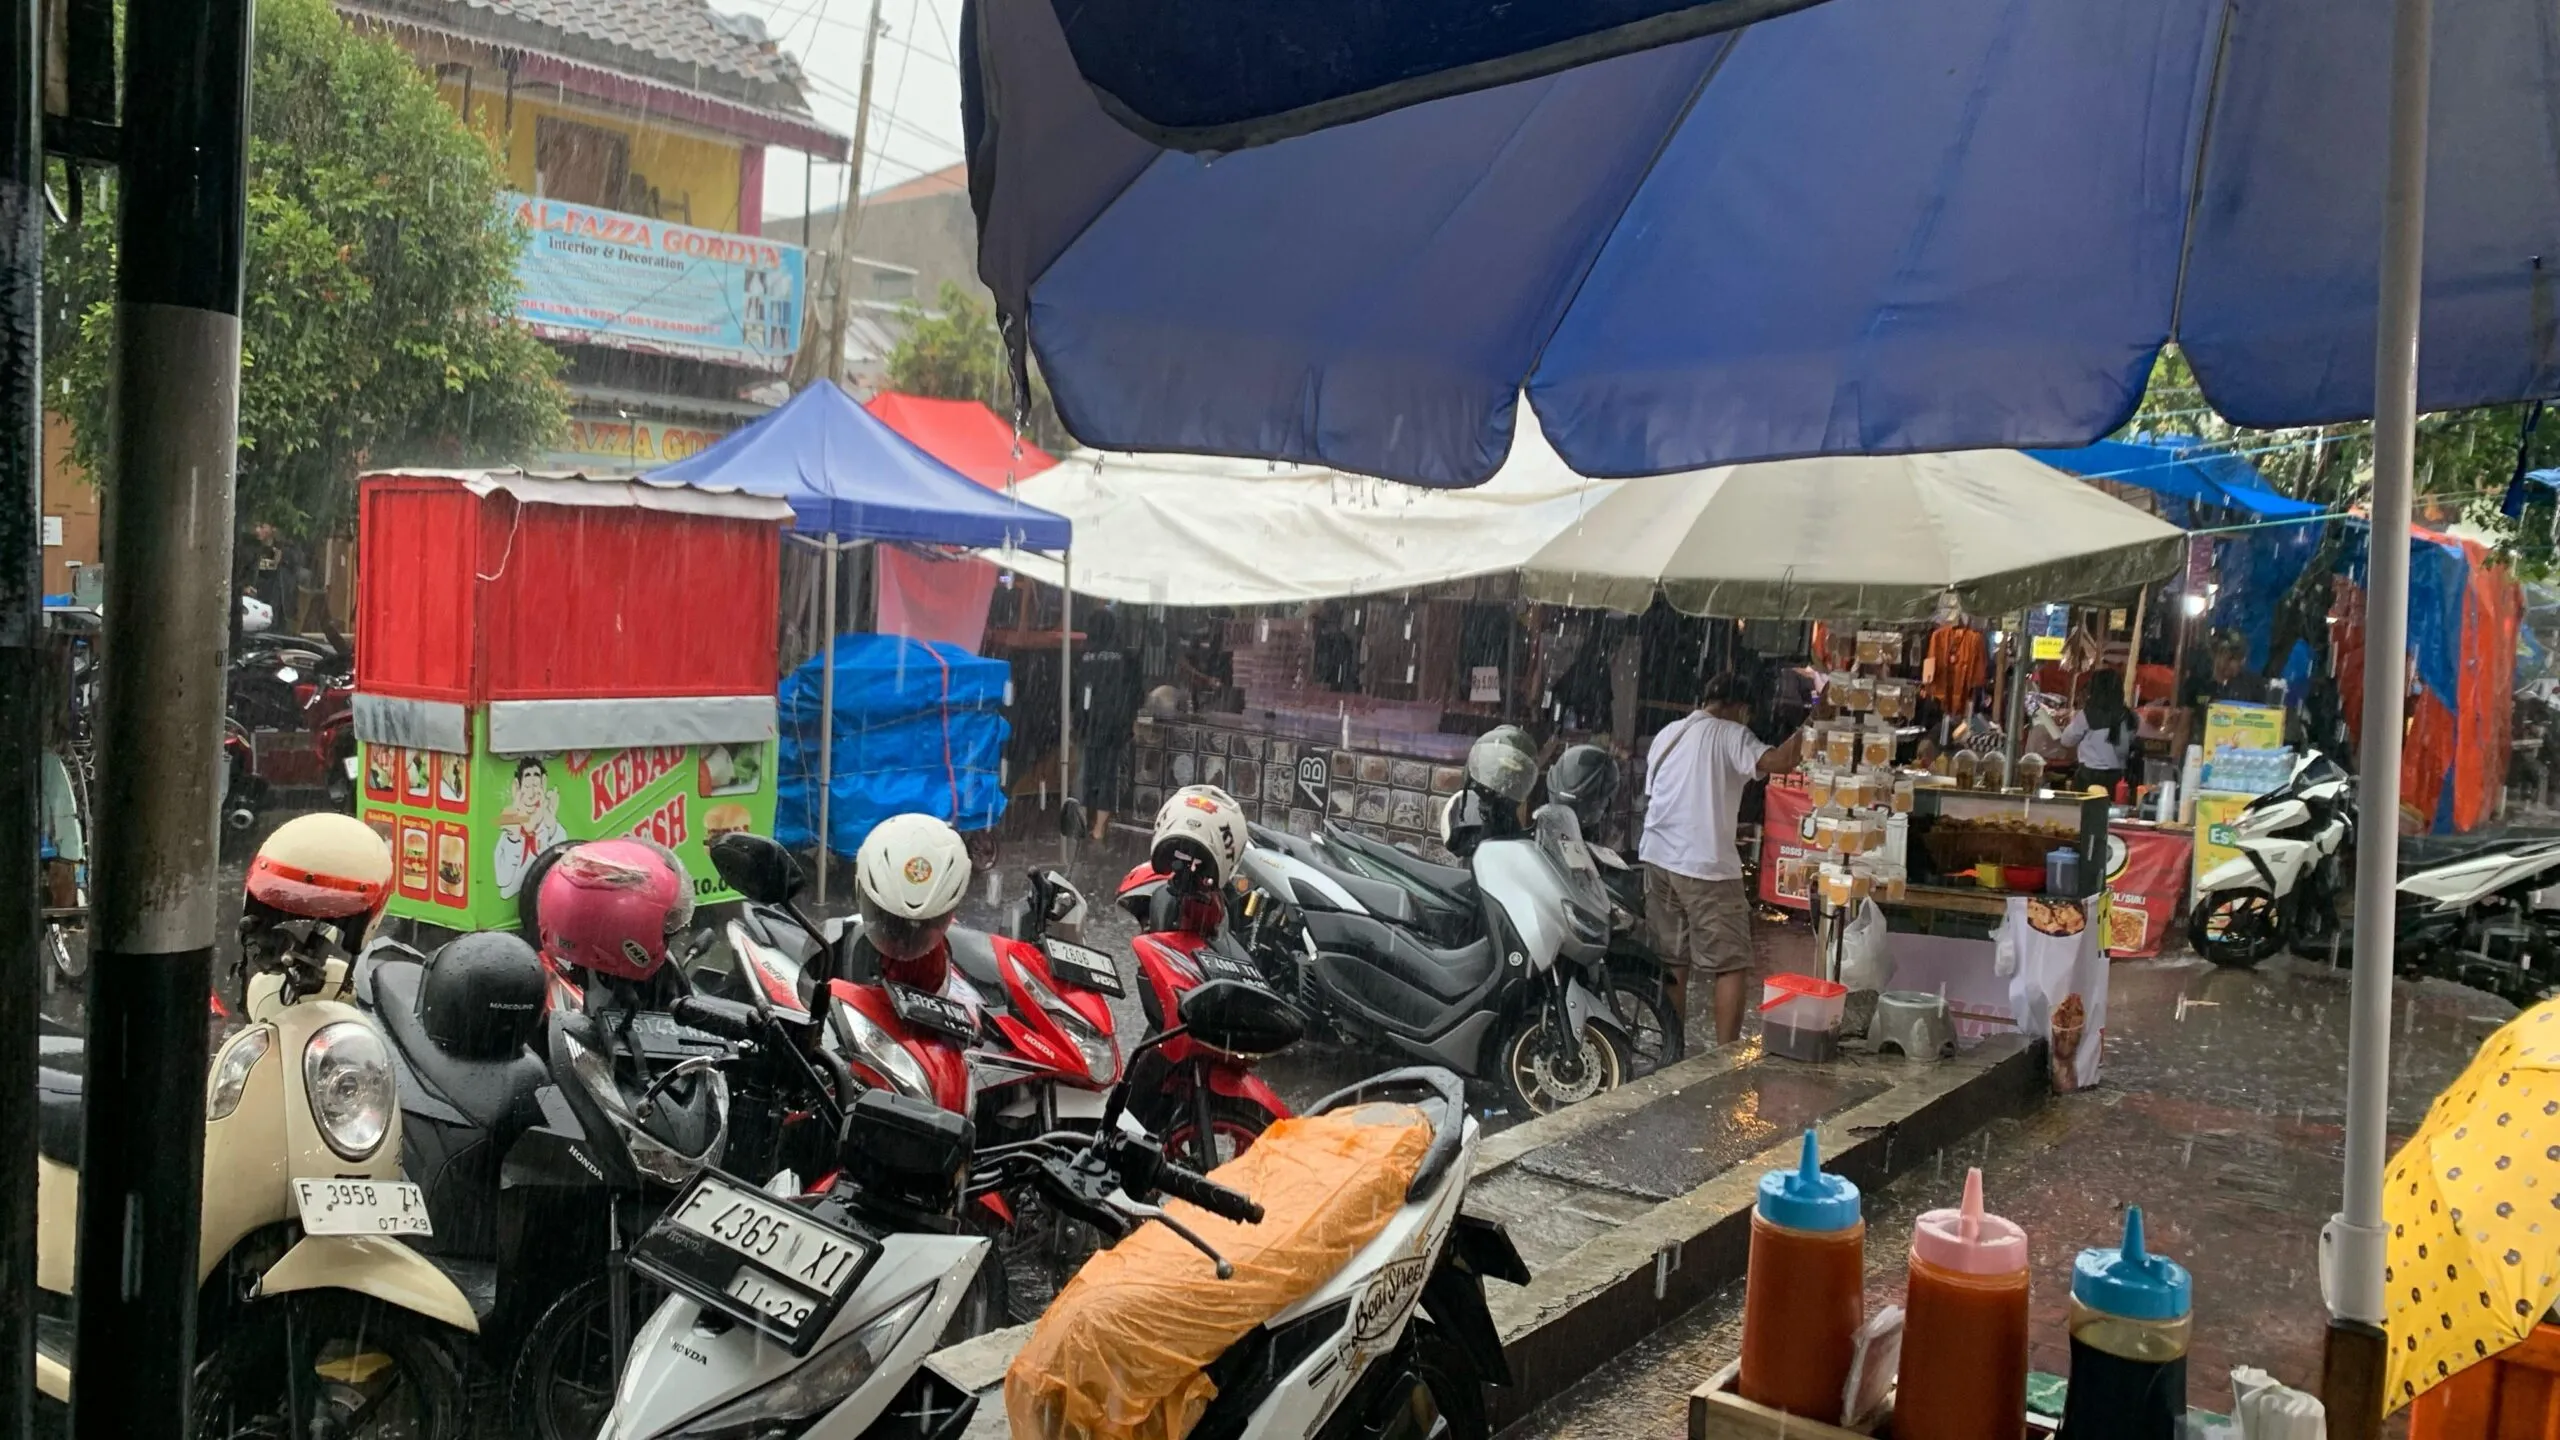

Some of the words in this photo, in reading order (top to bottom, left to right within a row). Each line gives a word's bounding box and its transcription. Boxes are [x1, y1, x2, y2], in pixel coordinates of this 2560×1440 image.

[549, 235, 598, 256] Interior
[603, 245, 614, 259] &
[619, 249, 685, 271] Decoration
[625, 941, 649, 964] INK
[1023, 1033, 1056, 1060] HONDA
[567, 1144, 604, 1181] HONDA
[300, 1183, 313, 1205] F
[326, 1184, 378, 1206] 3958
[676, 1186, 713, 1220] F
[710, 1202, 790, 1257] 4365
[800, 1240, 854, 1289] XI
[670, 1342, 708, 1366] HONDA
